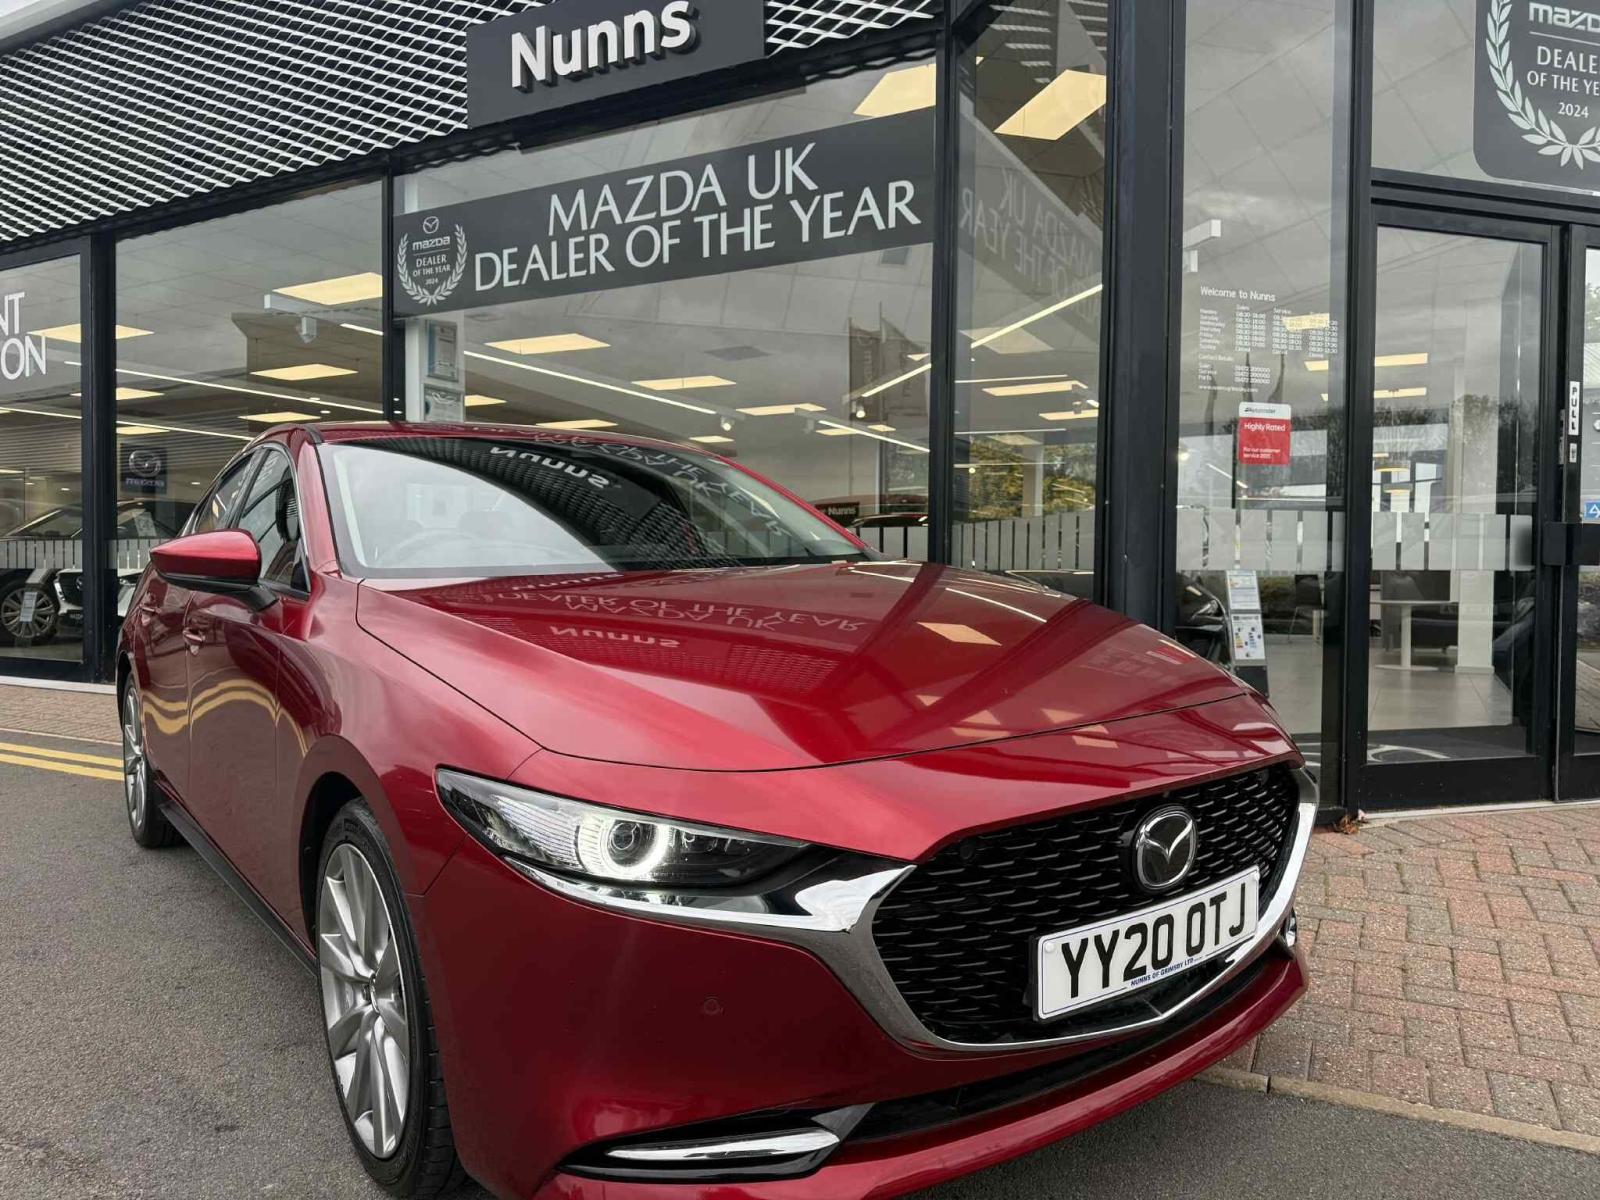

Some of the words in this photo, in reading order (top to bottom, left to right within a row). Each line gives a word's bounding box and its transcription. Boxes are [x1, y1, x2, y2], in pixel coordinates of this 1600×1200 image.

[511, 0, 695, 88] Nunns
[1527, 70, 1548, 87] OF
[1551, 74, 1579, 92] THE
[1558, 102, 1589, 118] 2024
[548, 163, 727, 237] MAZDA
[747, 141, 819, 201] UK
[474, 231, 616, 292] DEALER
[626, 218, 682, 269] OF
[694, 204, 775, 259] THE
[789, 179, 922, 243] YEAR
[412, 269, 421, 277] OF
[422, 266, 434, 275] THE
[435, 263, 452, 273] YEAR
[416, 254, 447, 268] DEALER
[1200, 286, 1236, 298] Welcome
[1239, 290, 1248, 299] to
[1250, 290, 1276, 302] Nunns
[1244, 422, 1265, 432] Highly
[1265, 423, 1286, 432] Rated
[1061, 914, 1174, 999] YY20
[1130, 975, 1151, 987] NUNNS
[1152, 970, 1160, 979] OF
[1160, 962, 1183, 976] GRIMSBY
[1184, 957, 1194, 966] LTD
